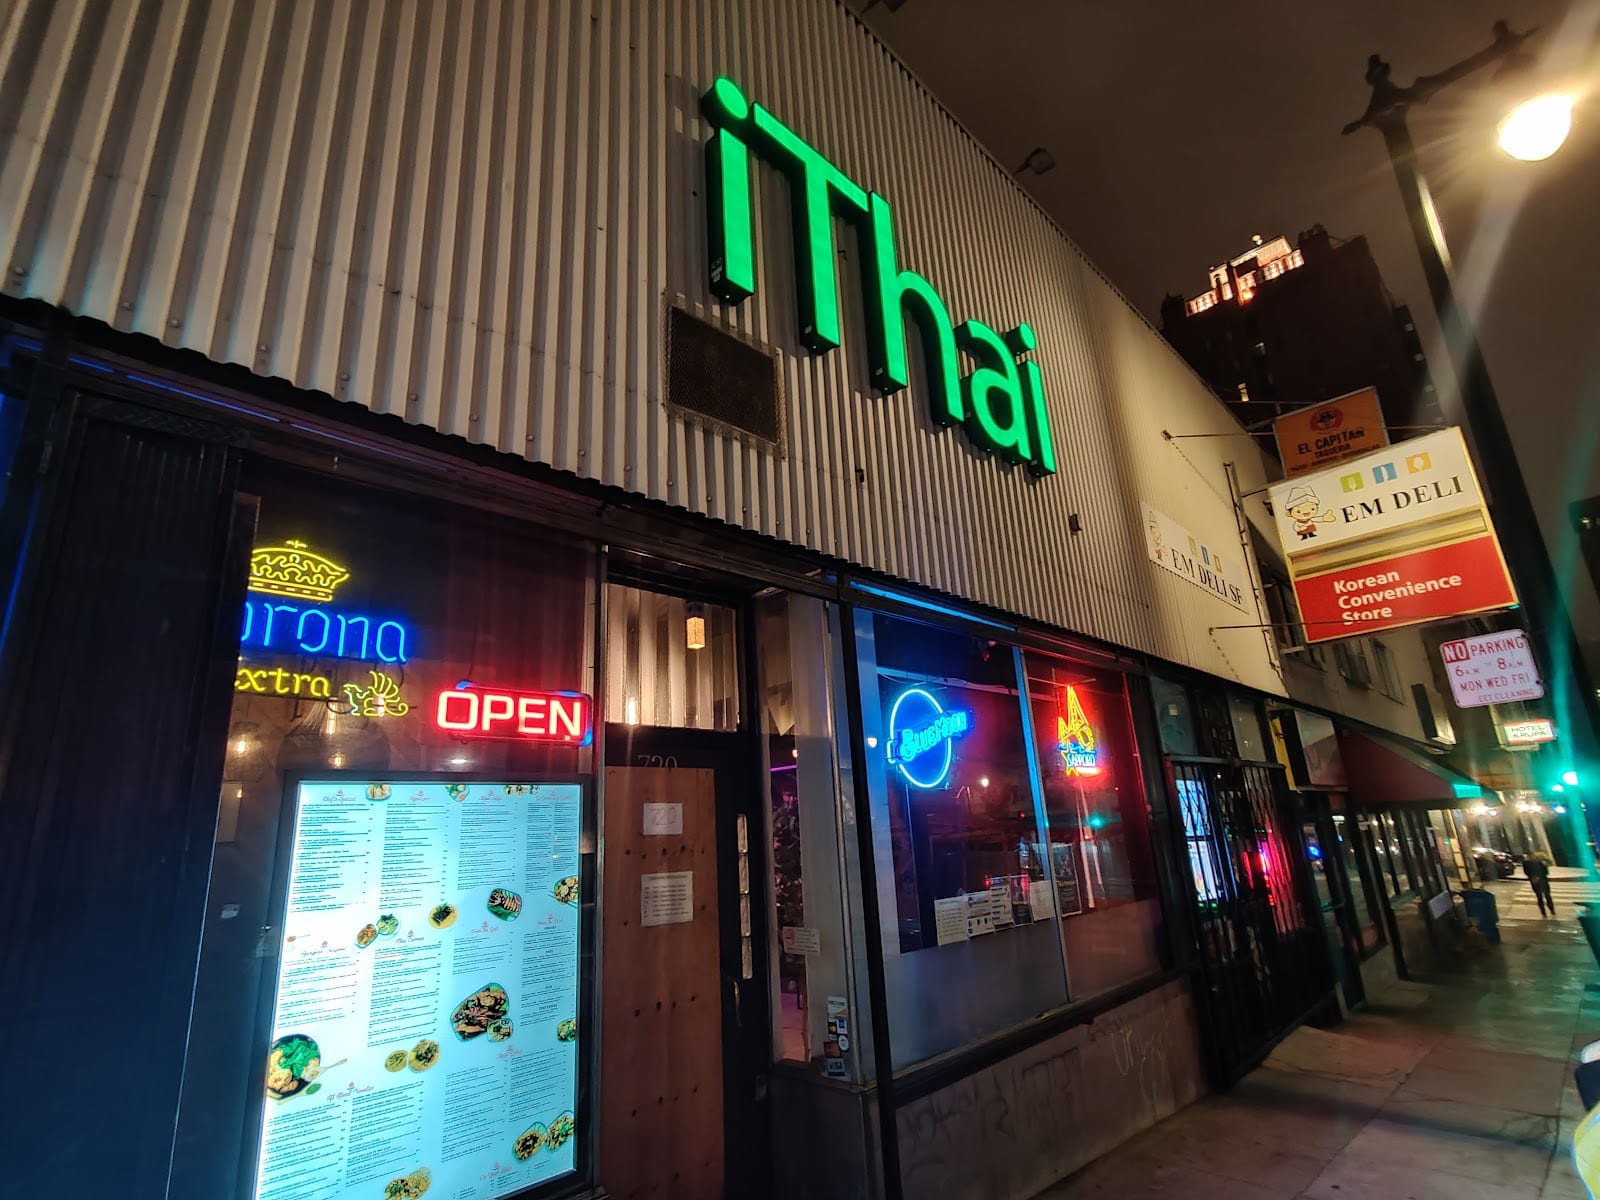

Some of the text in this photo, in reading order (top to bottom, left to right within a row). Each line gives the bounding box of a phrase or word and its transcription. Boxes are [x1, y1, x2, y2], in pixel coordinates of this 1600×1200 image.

[714, 76, 1056, 473] iThai
[1297, 428, 1366, 455] EL CAPITAN
[1341, 475, 1464, 524] EM DELI
[1171, 547, 1242, 605] EM DELI SF
[1333, 569, 1400, 595] Korean
[1337, 573, 1463, 609] Convenience
[1342, 606, 1393, 626] Store
[241, 601, 407, 662] rona
[1443, 636, 1524, 662] NO PARKING
[234, 667, 330, 697] xtra
[1460, 672, 1531, 692] MON WED FRI
[436, 690, 582, 737] OPEN
[1511, 724, 1547, 733] HOTEL
[1513, 730, 1546, 738] KRUPA
